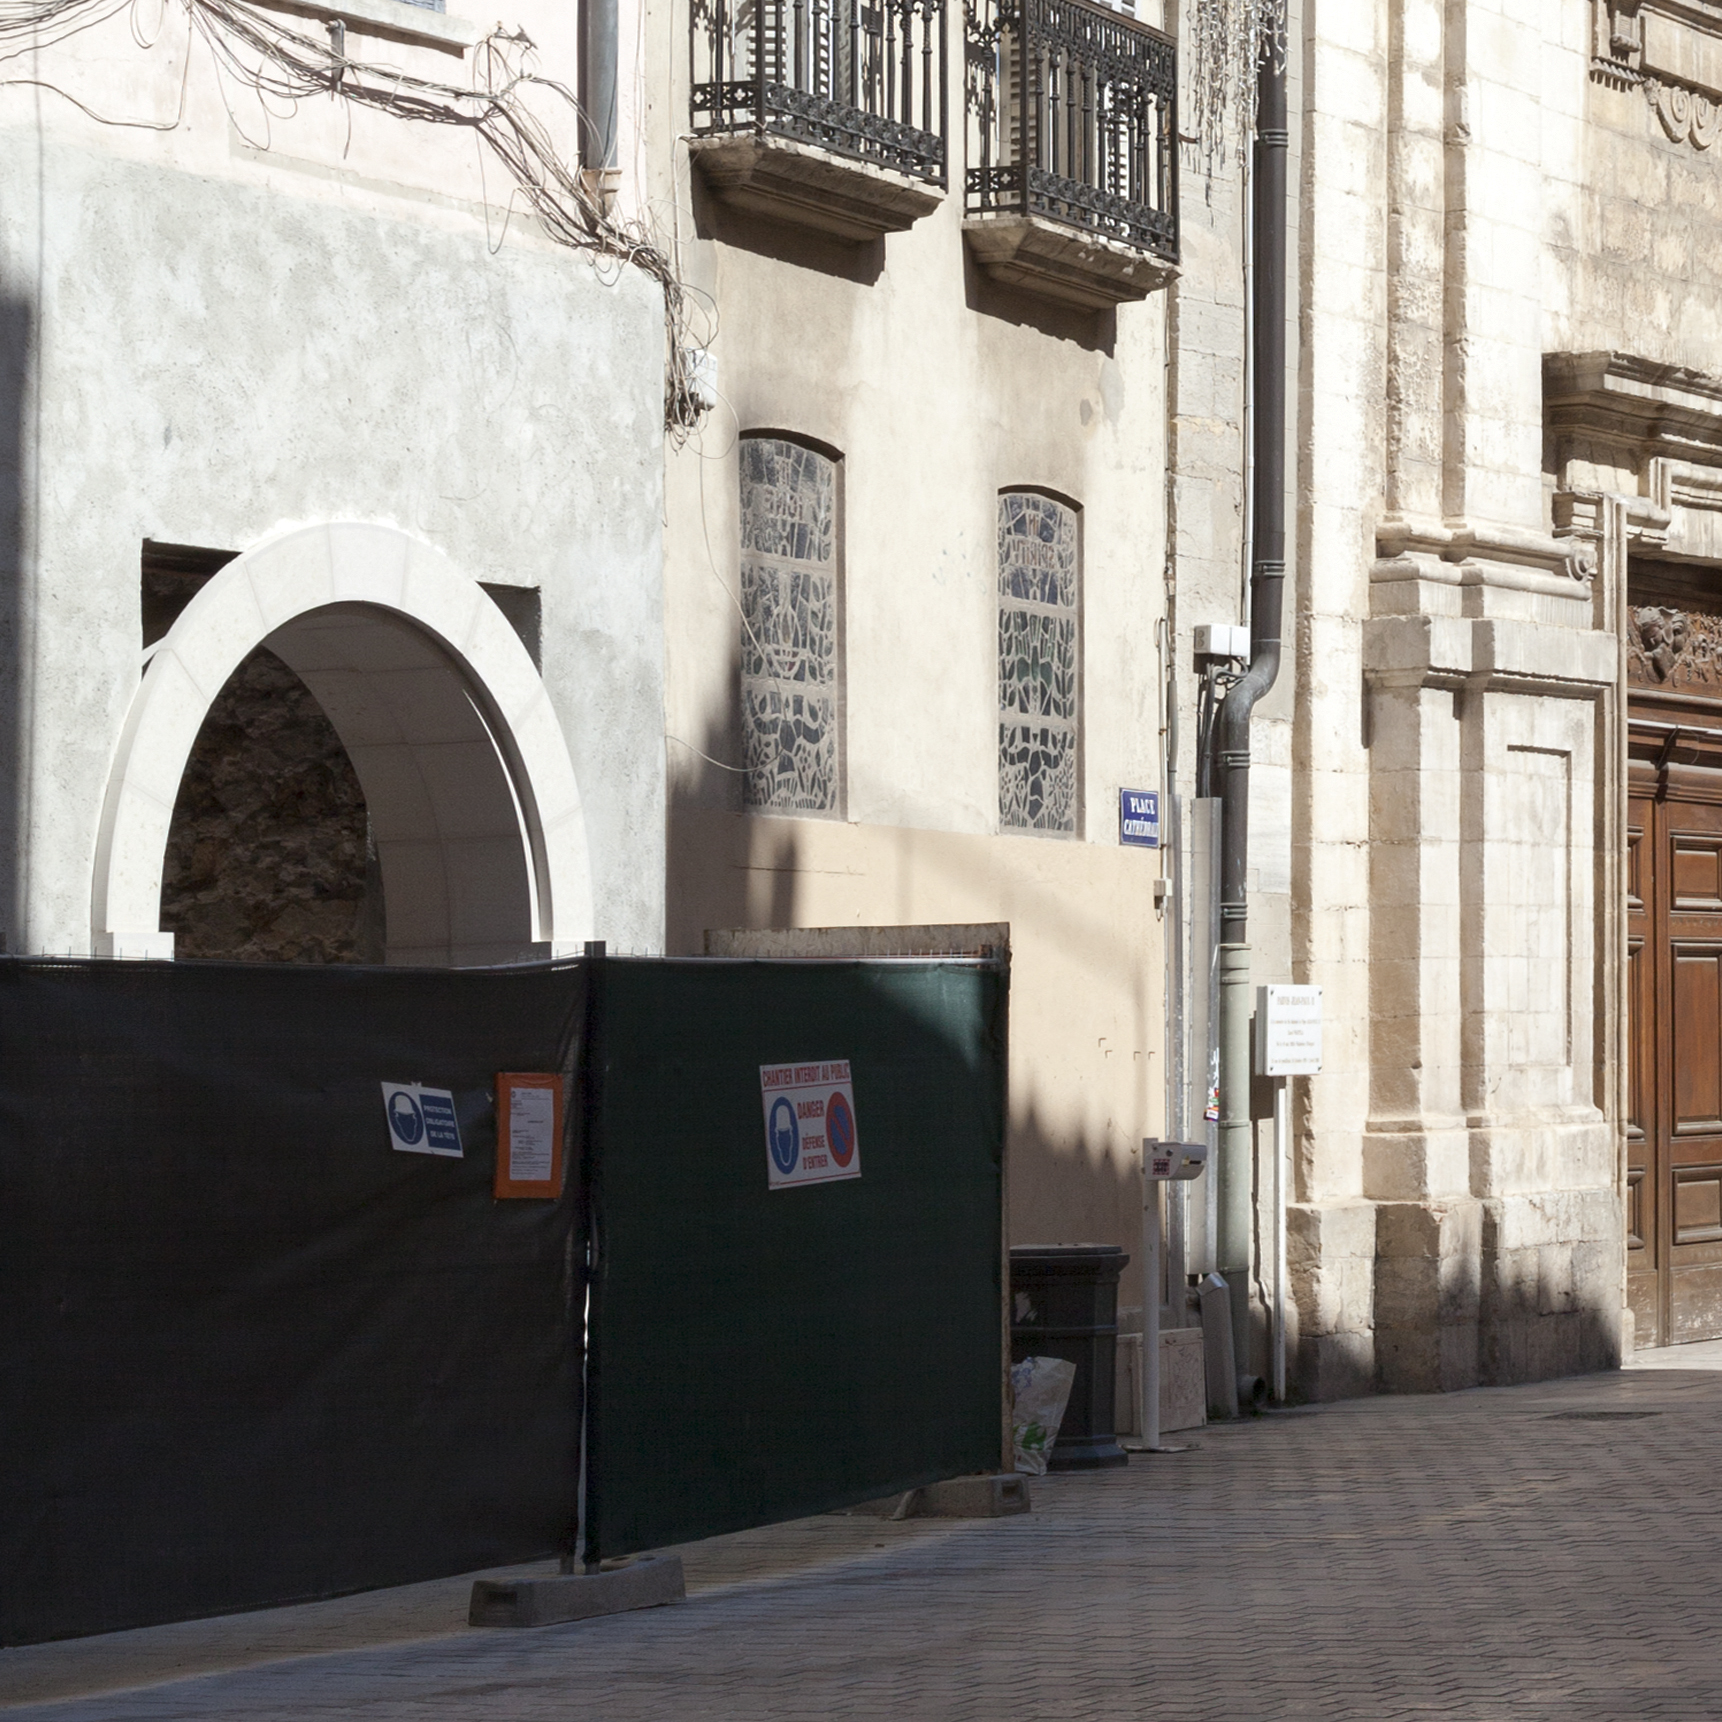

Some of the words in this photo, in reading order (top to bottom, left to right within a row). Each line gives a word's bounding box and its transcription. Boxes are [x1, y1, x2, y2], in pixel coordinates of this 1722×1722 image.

[1130, 797, 1155, 815] PLACE
[762, 1067, 793, 1088] CHANTIER
[794, 1065, 820, 1084] INTERDIT
[821, 1064, 830, 1081] AU
[830, 1062, 850, 1080] PUBLIC
[797, 1099, 825, 1120] DANGER
[801, 1132, 826, 1150] DÉFENSE
[802, 1153, 829, 1171] D'ENTRER
